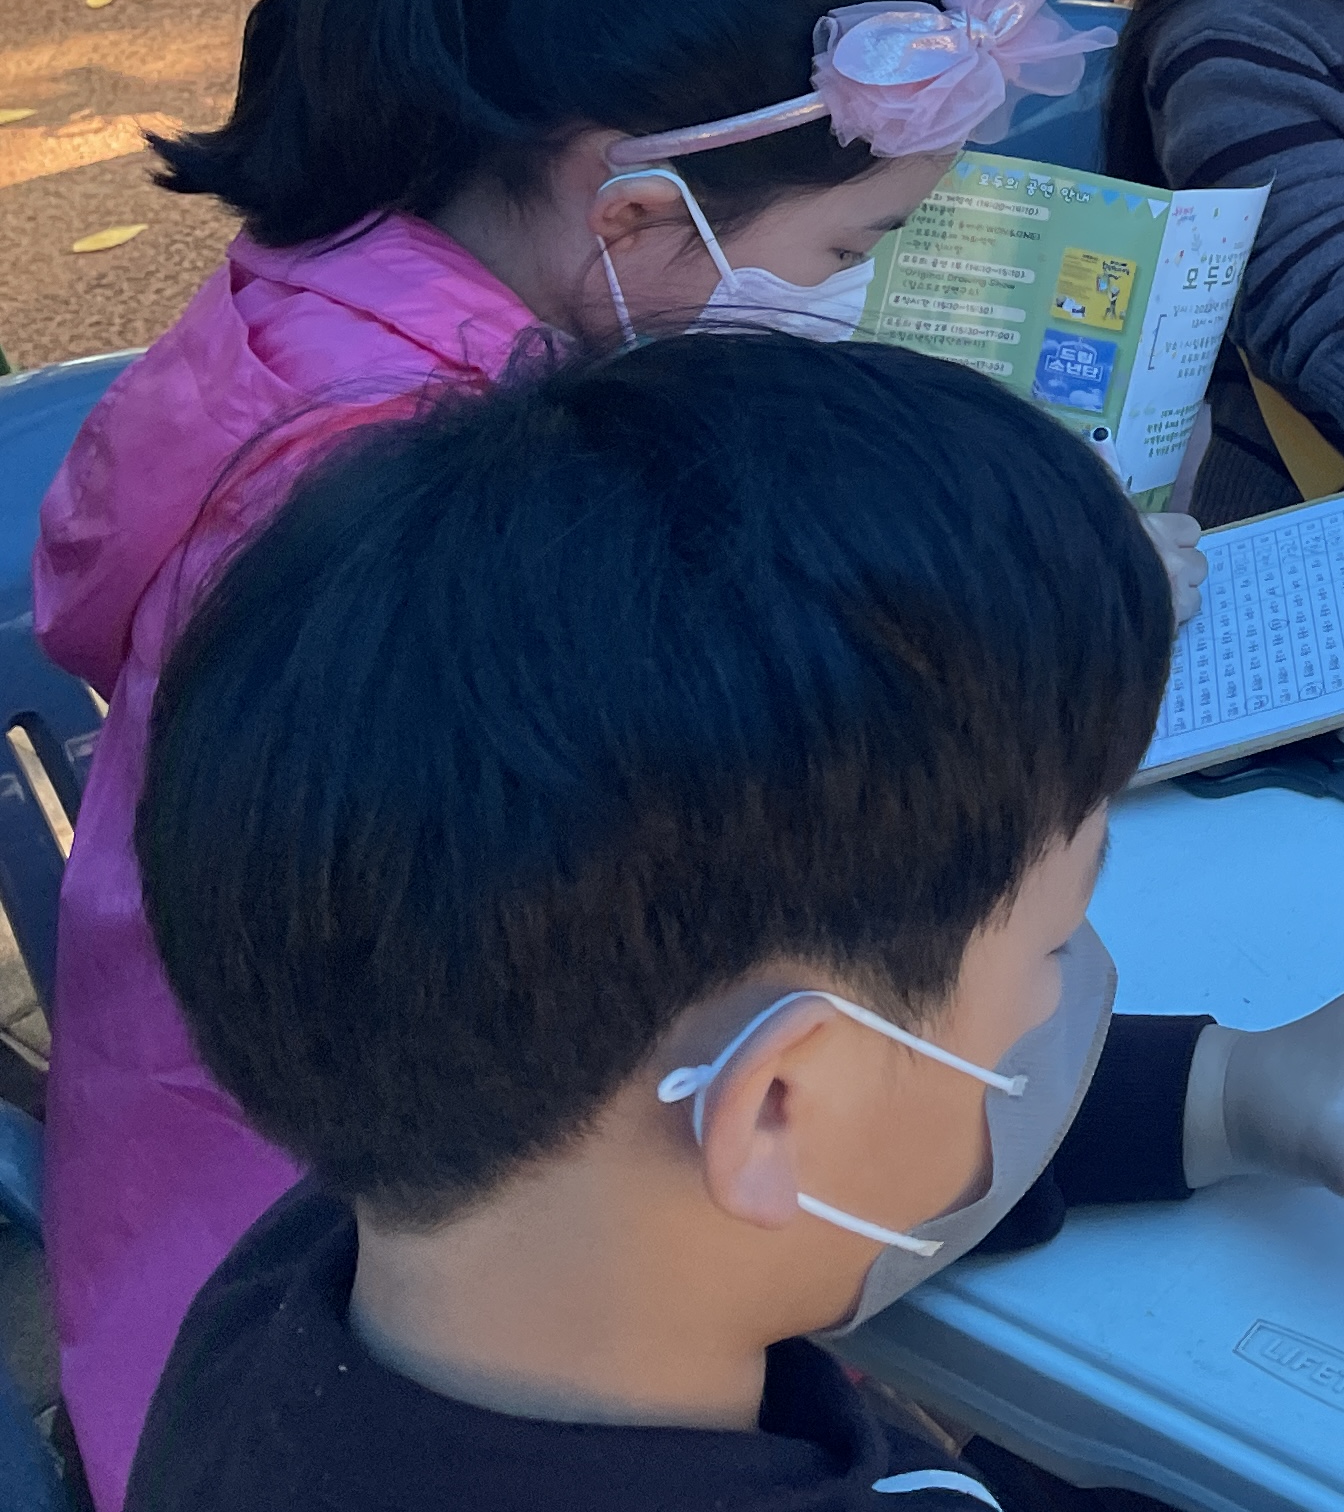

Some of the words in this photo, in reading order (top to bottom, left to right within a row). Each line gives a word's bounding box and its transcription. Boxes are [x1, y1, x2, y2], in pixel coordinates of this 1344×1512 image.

[977, 172, 1020, 192] 모두의
[1027, 177, 1054, 199] 공연
[1061, 182, 1091, 204] 안내
